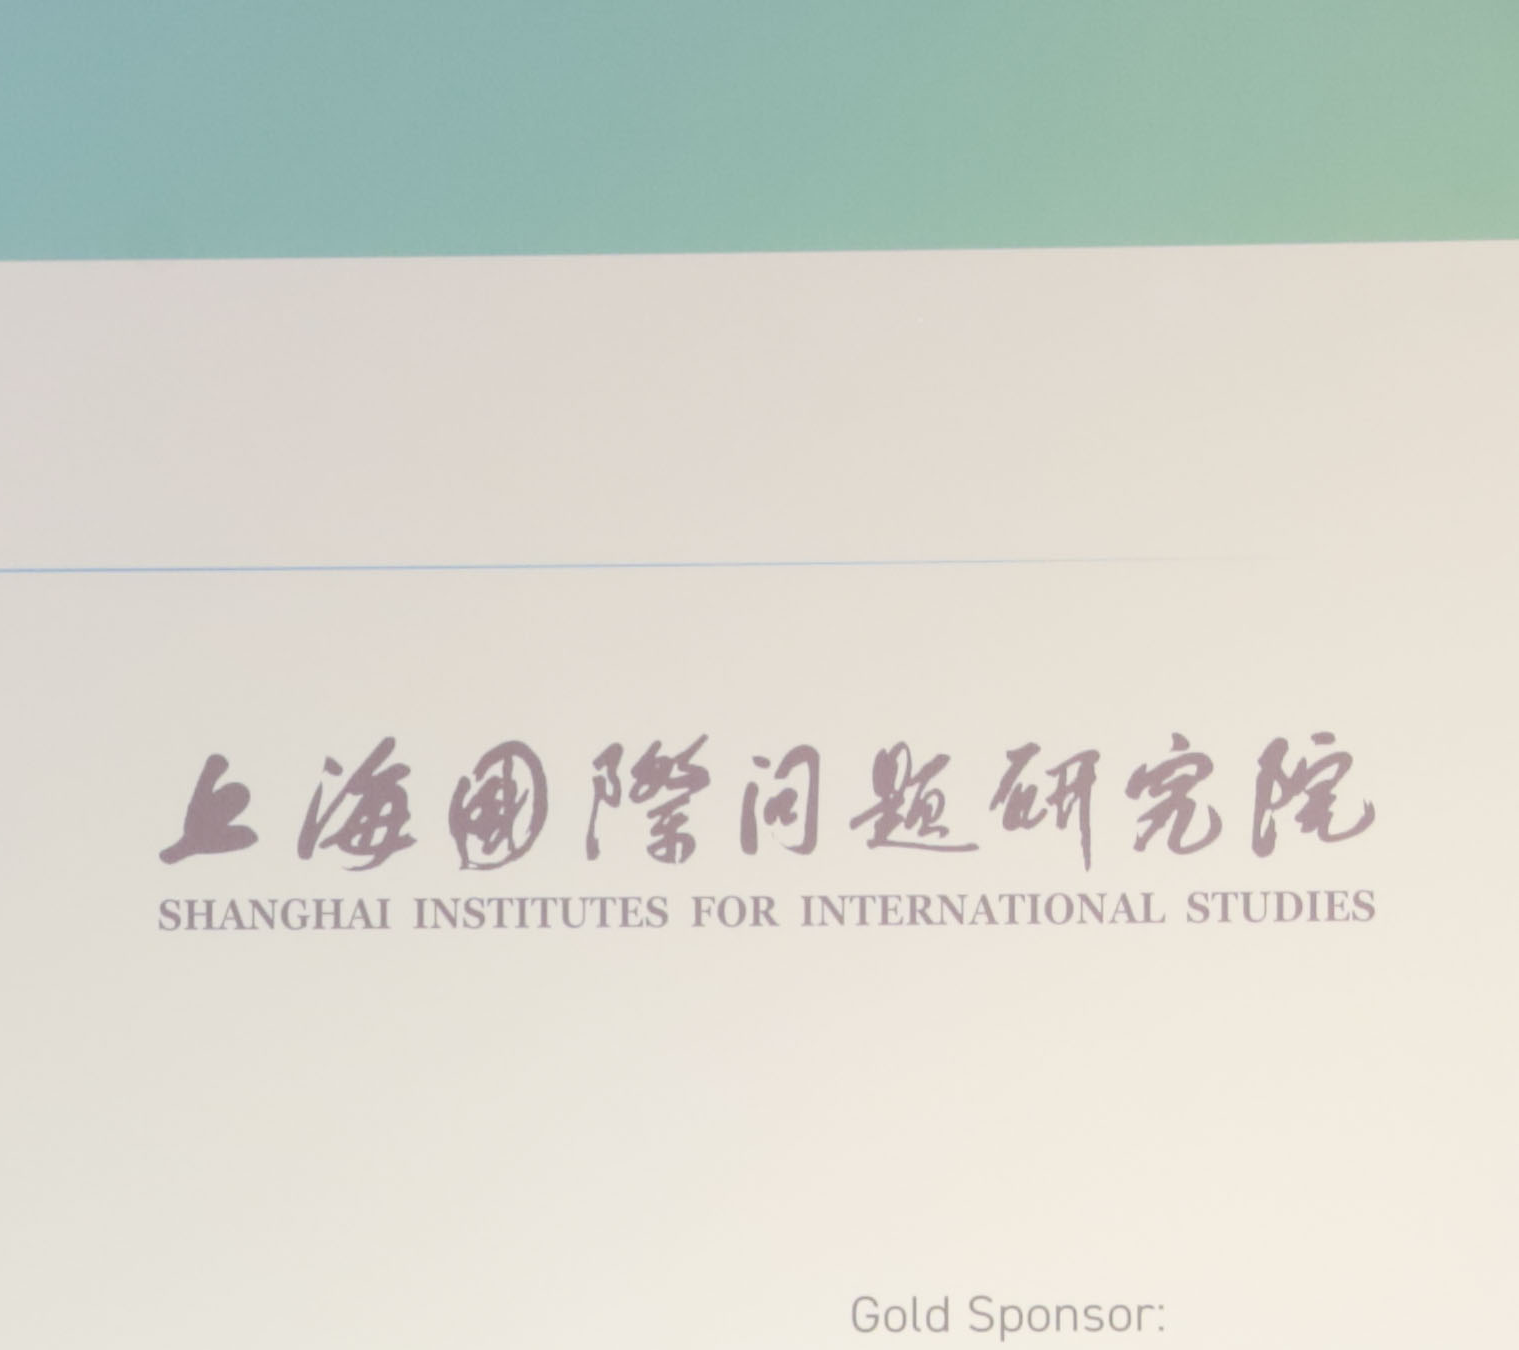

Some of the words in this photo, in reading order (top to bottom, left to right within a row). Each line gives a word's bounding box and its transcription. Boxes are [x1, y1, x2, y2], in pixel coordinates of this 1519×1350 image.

[159, 899, 389, 931] SHANGHAI
[415, 897, 668, 929] INSTITUTES
[692, 896, 778, 927] FOR
[802, 893, 1165, 926] INTERNATIONAL
[1187, 890, 1375, 923] STUDIES
[852, 1296, 949, 1333] Gold
[969, 1295, 1164, 1342] Sponsor:
